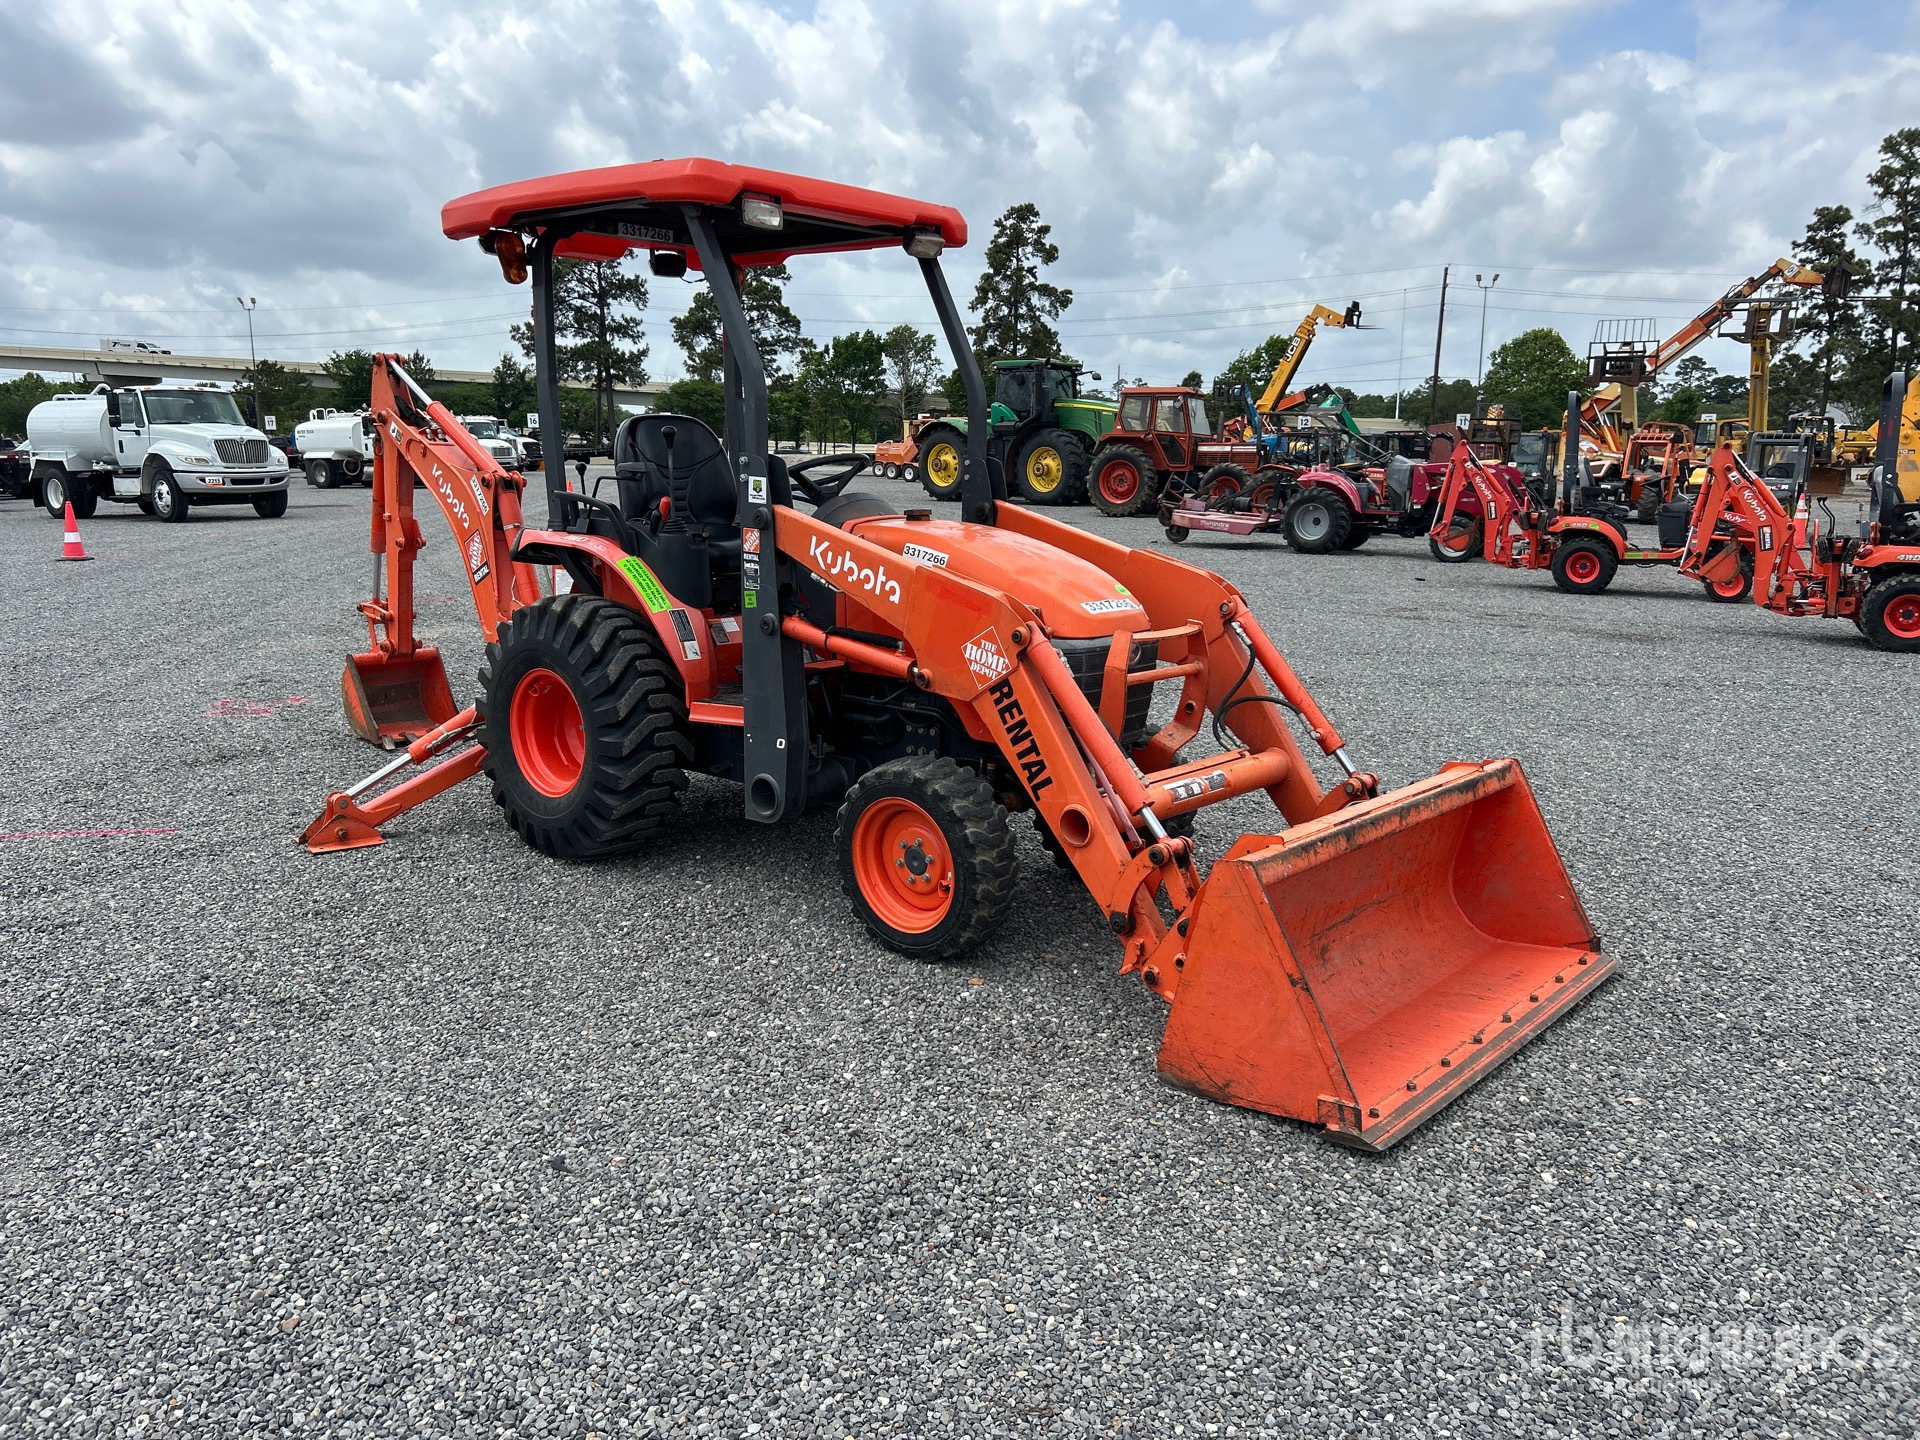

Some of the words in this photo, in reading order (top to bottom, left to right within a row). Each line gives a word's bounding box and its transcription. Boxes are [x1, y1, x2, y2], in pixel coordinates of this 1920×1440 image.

[622, 223, 671, 241] 3317266
[1285, 336, 1300, 361] JCB
[1300, 418, 1309, 426] 12
[432, 463, 470, 529] Kubota
[471, 477, 488, 514] 3317266
[1475, 476, 1493, 500] Kubota
[1743, 490, 1767, 522] Kubota
[1200, 519, 1229, 528] Mahindra
[903, 545, 947, 566] 3317266
[809, 534, 901, 605] Kubota
[980, 639, 998, 653] THE
[964, 643, 1008, 674] HOME
[970, 661, 998, 680] DEPOT
[988, 677, 1054, 802] RENTAL
